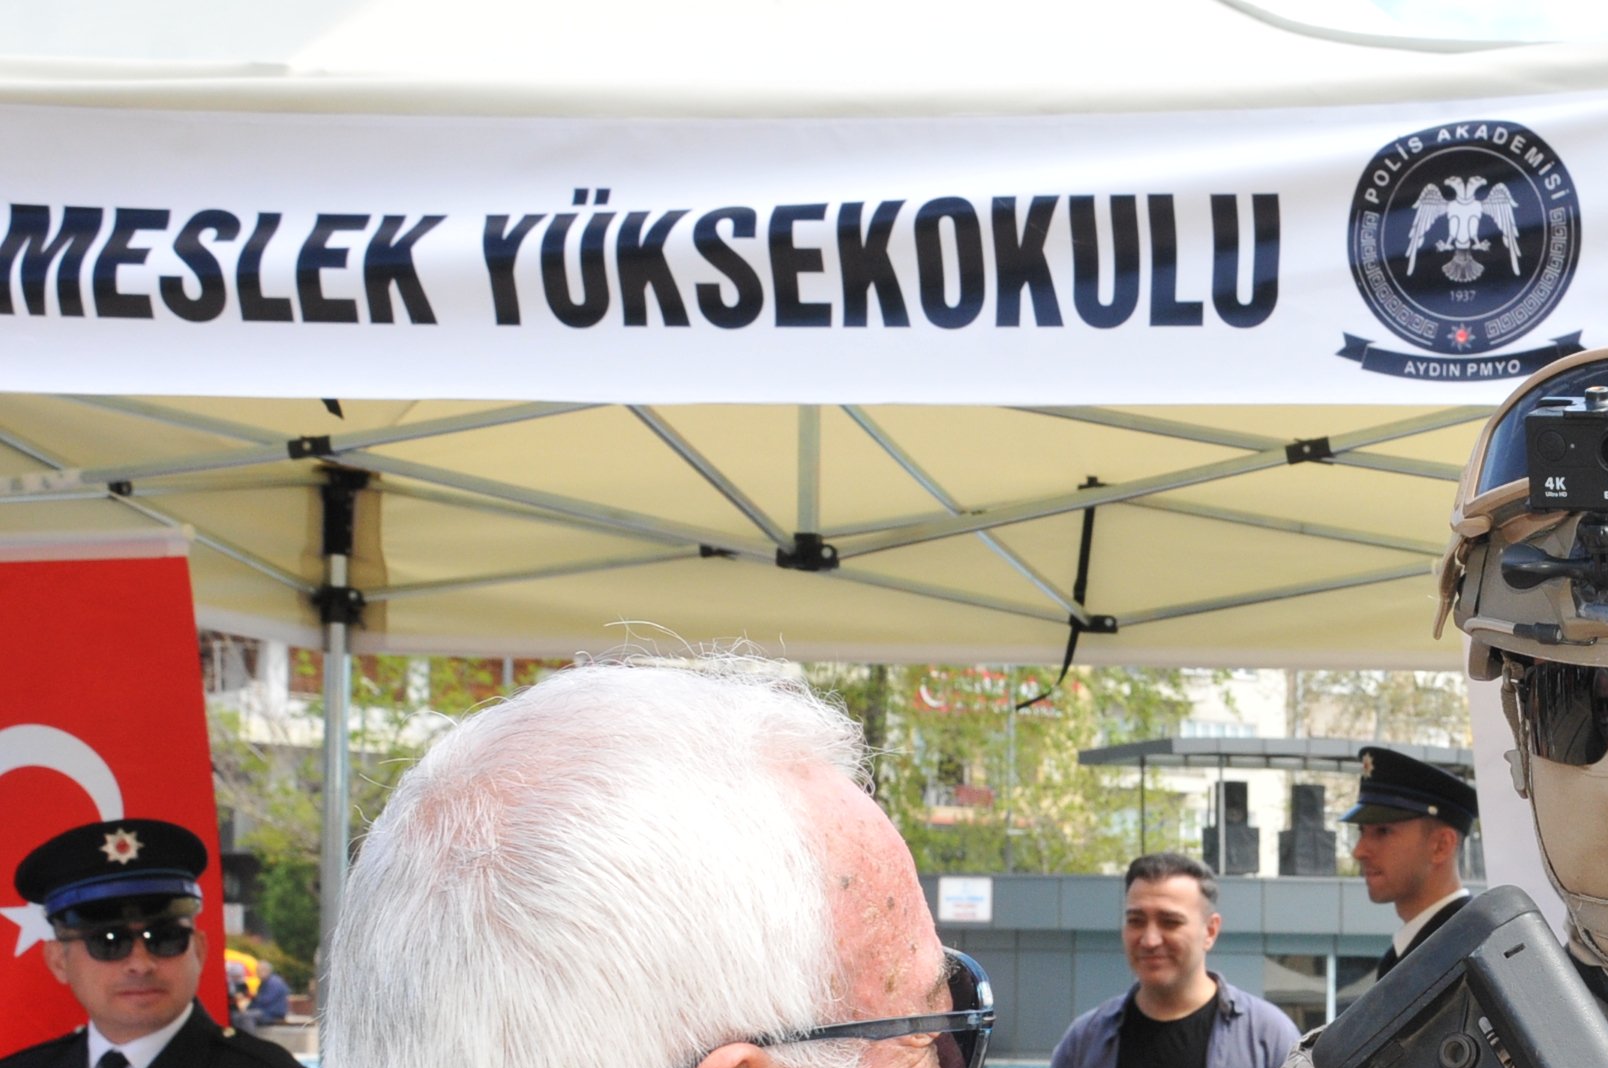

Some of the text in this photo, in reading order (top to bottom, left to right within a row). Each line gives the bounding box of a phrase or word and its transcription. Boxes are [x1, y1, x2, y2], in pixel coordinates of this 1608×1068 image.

[0, 187, 1281, 330] MESLEK YÜKSEKOKULU
[1450, 290, 1476, 302] 1937
[1403, 359, 1521, 377] AYDIN PMYO
[1544, 476, 1567, 491] 4K
